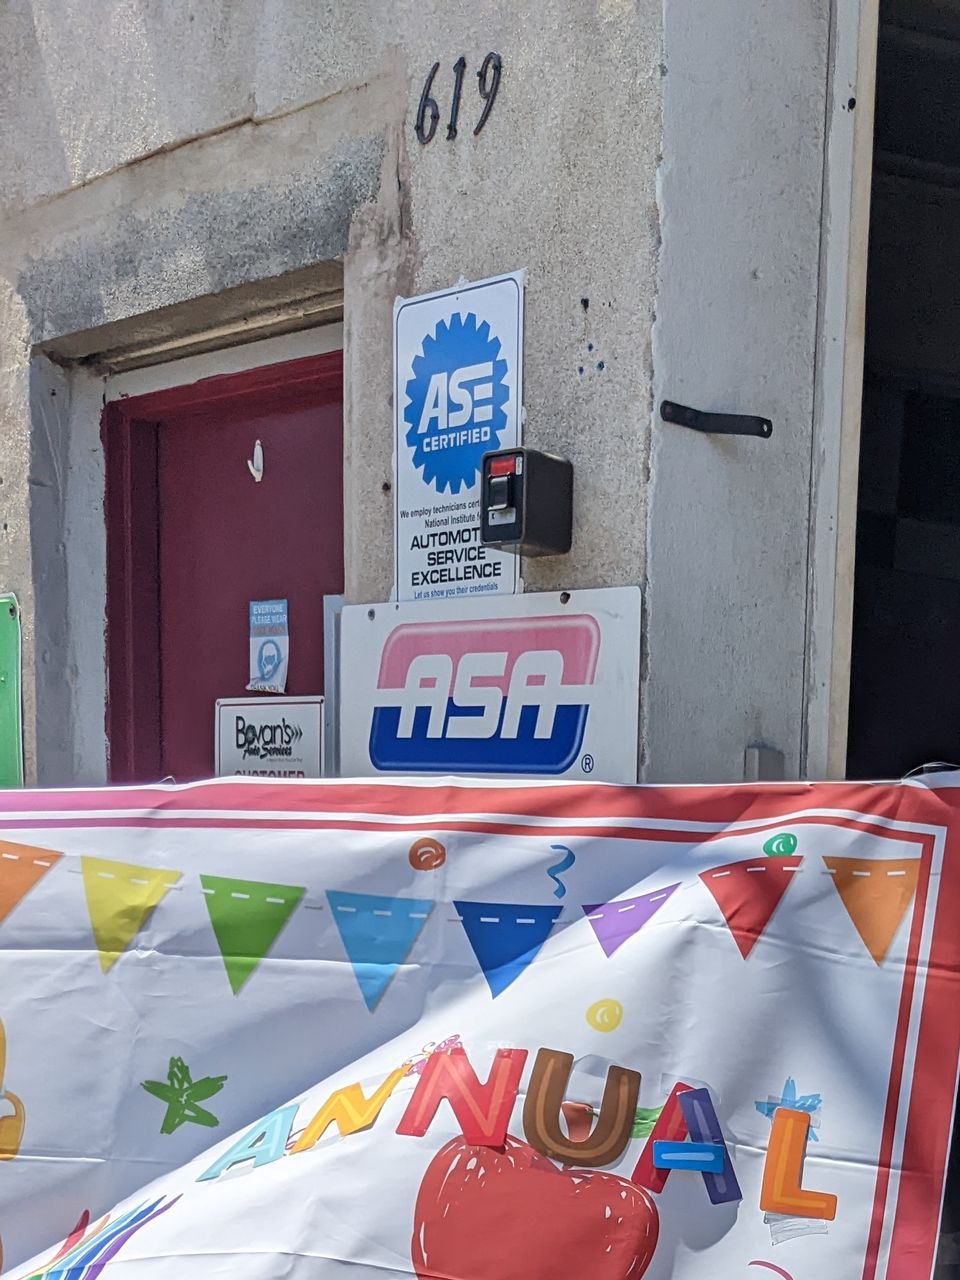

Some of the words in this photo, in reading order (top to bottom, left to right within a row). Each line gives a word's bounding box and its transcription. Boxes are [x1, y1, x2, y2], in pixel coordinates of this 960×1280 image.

[414, 52, 502, 144] 619
[417, 361, 493, 434] ASE
[423, 426, 490, 452] CERTIFIED
[400, 510, 409, 519] We
[410, 507, 432, 517] employ
[433, 502, 467, 515] technicians
[468, 500, 481, 509] cert
[425, 516, 450, 528] National
[450, 513, 476, 525] Institute
[410, 527, 481, 550] AUTOMOT
[427, 546, 486, 566] SERVICE
[411, 562, 501, 586] EXCELLENCE
[414, 590, 423, 599] Let
[423, 590, 431, 598] us
[431, 587, 445, 597] show
[446, 587, 456, 598] you
[456, 585, 469, 594] their
[470, 582, 499, 592] credentials
[396, 650, 566, 739] ASA
[195, 1047, 837, 1221] ANNUAL
